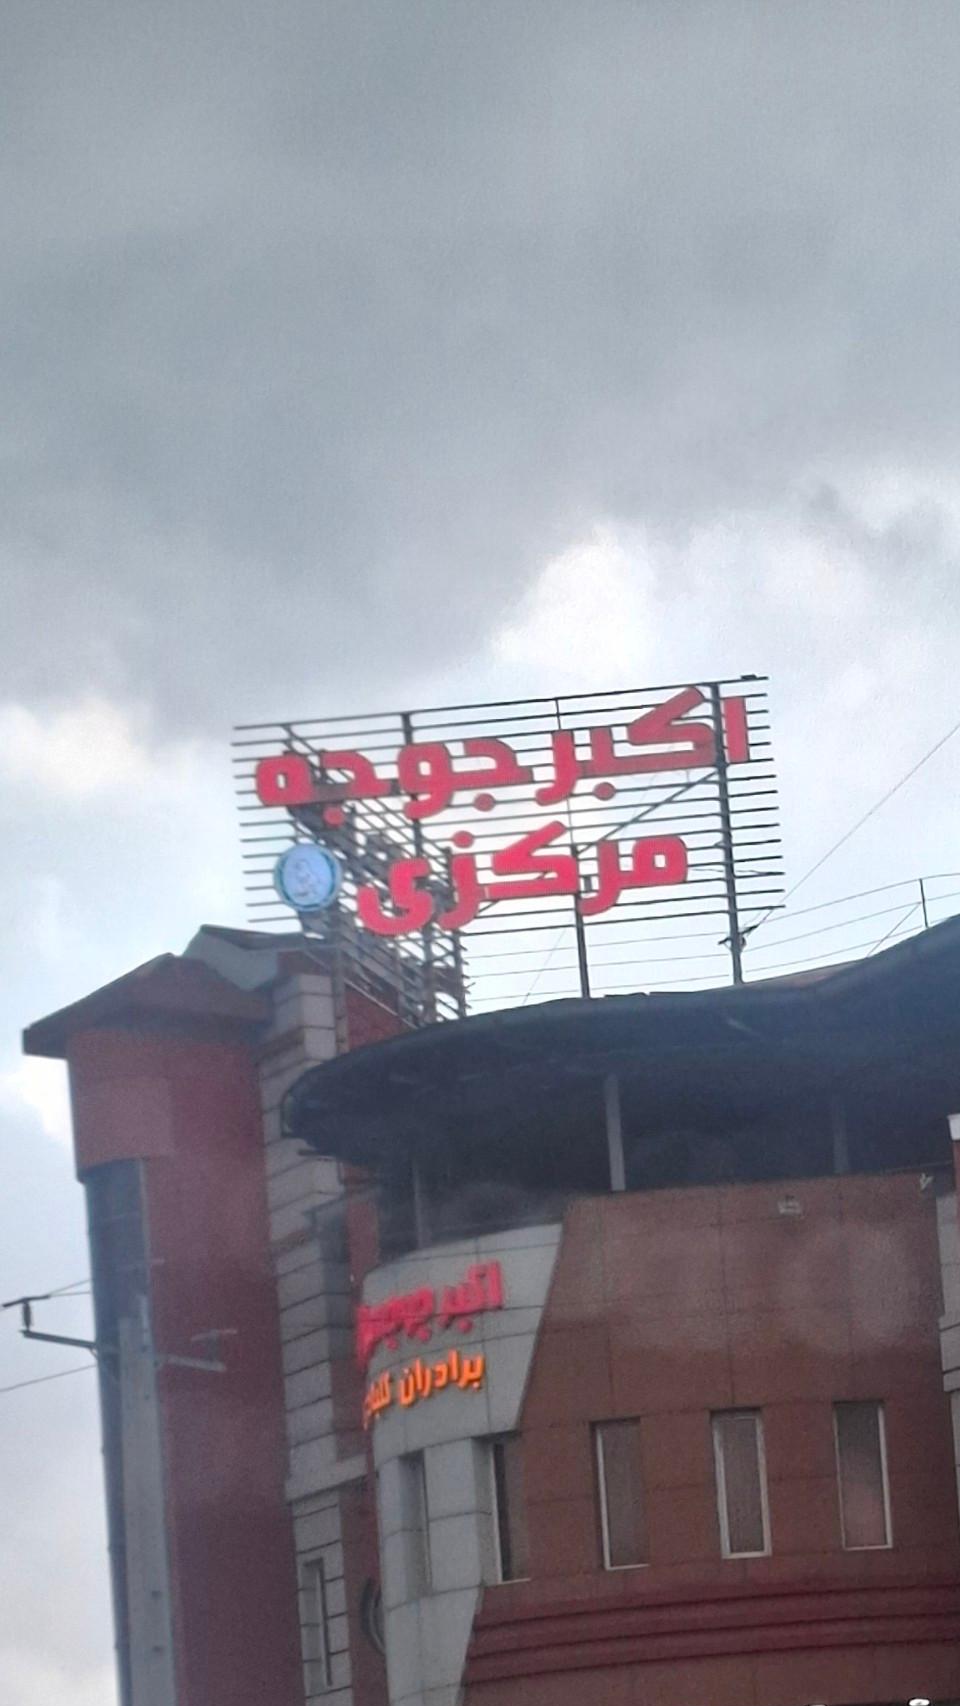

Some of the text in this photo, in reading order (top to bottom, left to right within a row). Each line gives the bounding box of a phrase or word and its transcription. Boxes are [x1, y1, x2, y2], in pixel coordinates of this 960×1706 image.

[255, 686, 751, 829] اکبر جوجه
[356, 820, 688, 936] مرکزی
